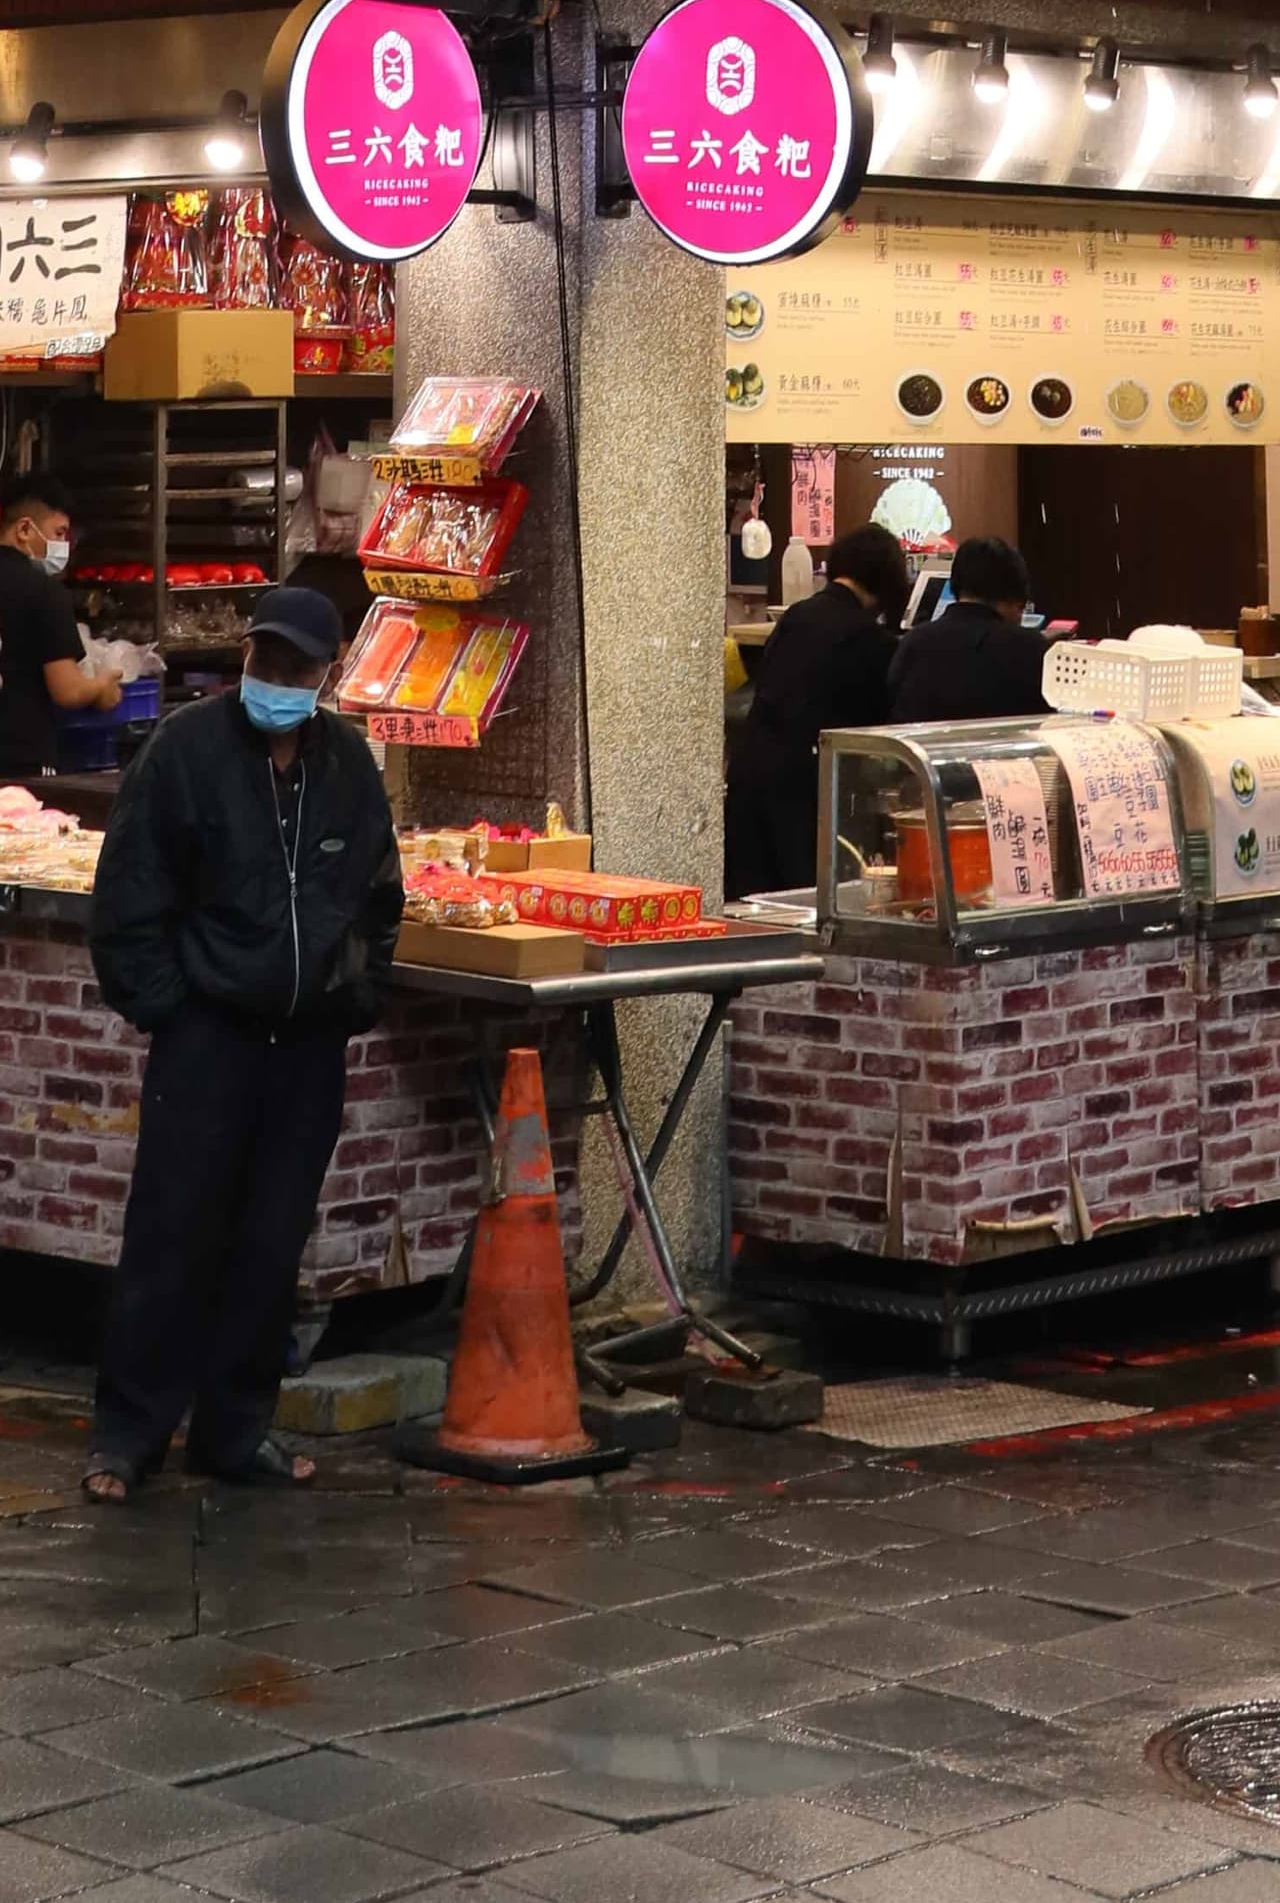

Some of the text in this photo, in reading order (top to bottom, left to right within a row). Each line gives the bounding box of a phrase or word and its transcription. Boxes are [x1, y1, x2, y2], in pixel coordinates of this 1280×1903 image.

[325, 121, 465, 170] 三六食粑
[643, 129, 812, 179] 三六食粑
[364, 177, 429, 191] RICECAKING
[686, 181, 765, 198] RICECAKING
